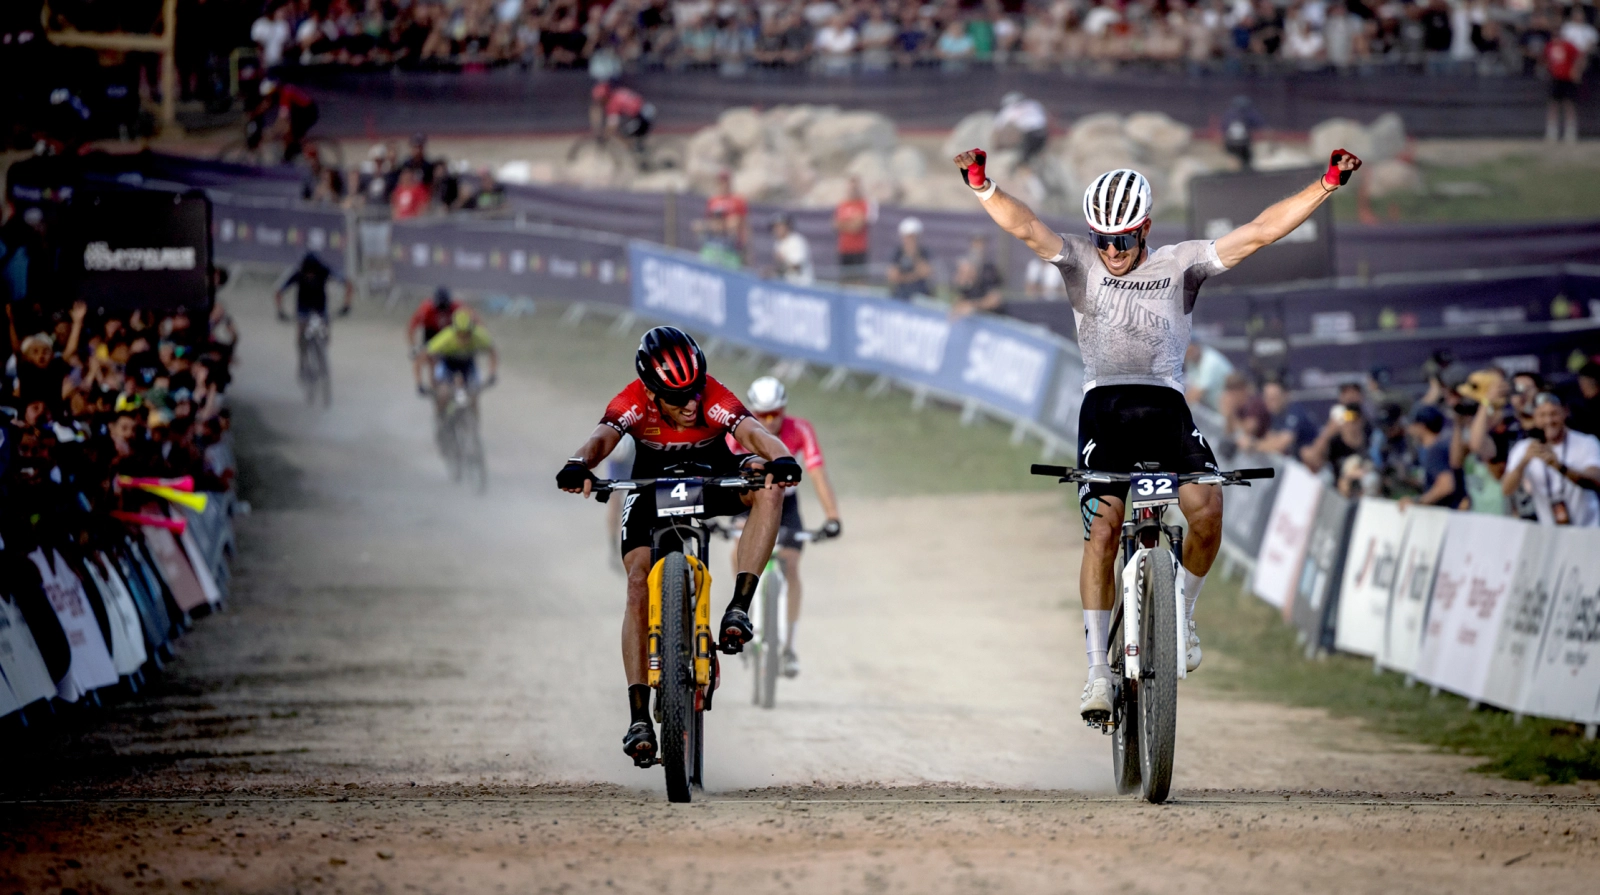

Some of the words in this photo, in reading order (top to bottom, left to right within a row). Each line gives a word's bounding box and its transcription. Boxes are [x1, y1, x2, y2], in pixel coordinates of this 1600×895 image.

[1100, 276, 1171, 291] SPECIALIZED
[618, 404, 644, 431] BMC
[707, 403, 737, 427] BMC
[642, 439, 713, 452] BMC
[670, 483, 688, 501] 4
[1137, 478, 1173, 496] 32
